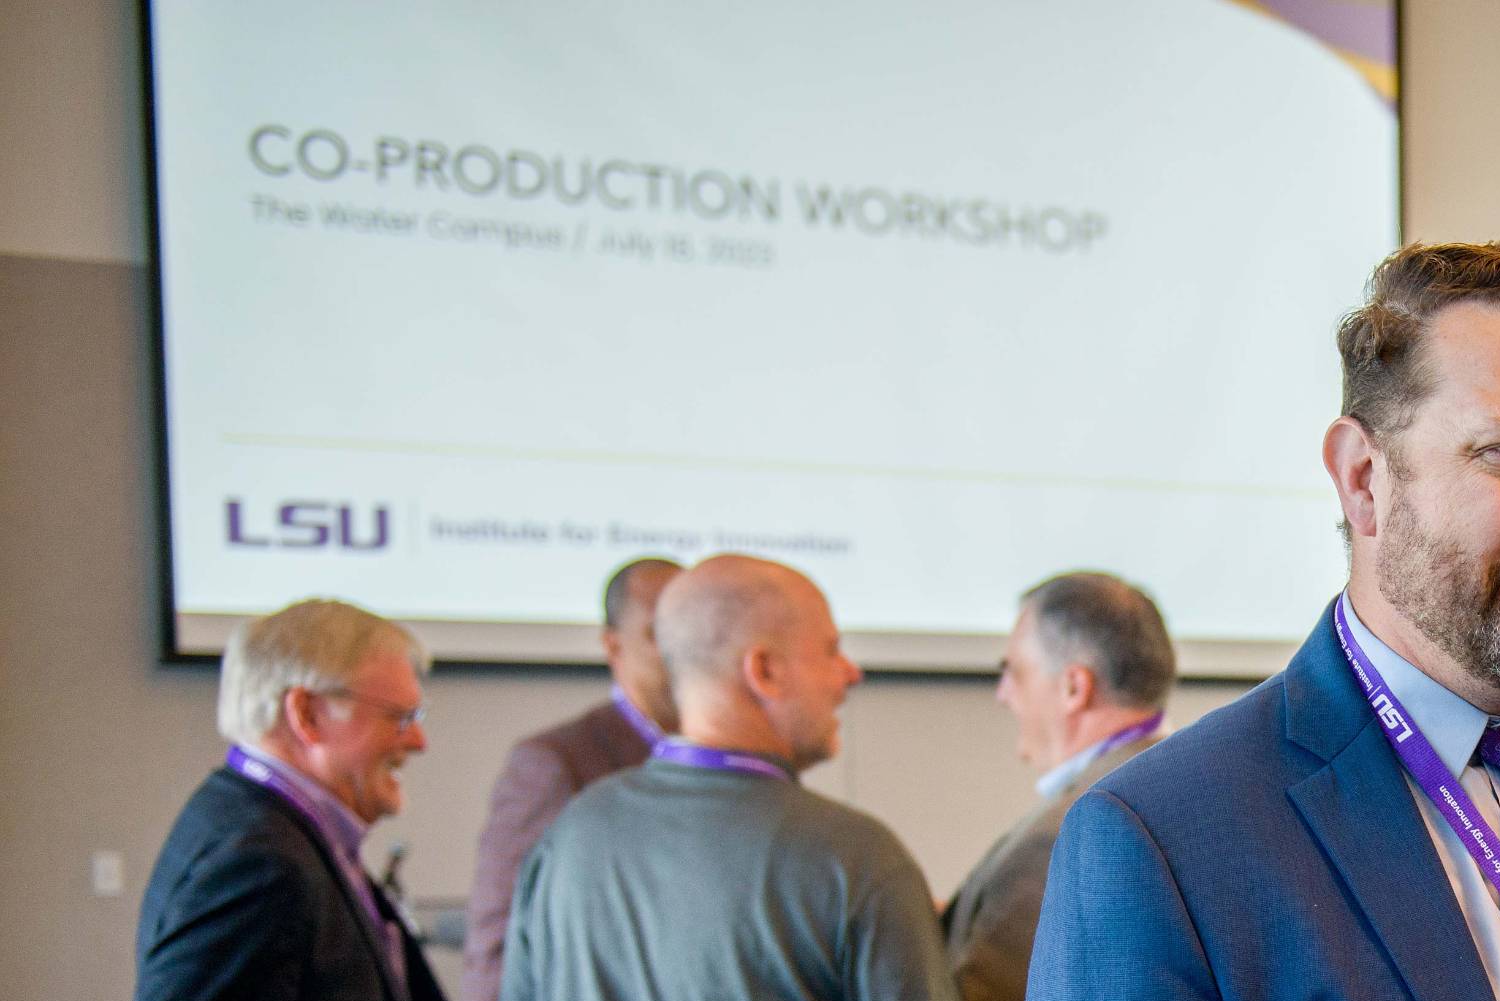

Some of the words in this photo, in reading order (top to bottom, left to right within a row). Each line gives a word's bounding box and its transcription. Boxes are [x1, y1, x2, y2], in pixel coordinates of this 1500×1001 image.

[248, 124, 781, 222] CO-PRODUCTION
[795, 180, 1109, 253] WORKSHOP
[251, 193, 310, 227] The
[319, 200, 417, 236] Water
[425, 209, 564, 249] Campus
[597, 231, 654, 262] July
[225, 496, 390, 551] LSU
[429, 514, 549, 543] Institute
[558, 519, 595, 544] for
[605, 521, 702, 549] Energy
[713, 526, 856, 553] Innovation
[1352, 659, 1373, 692] Institute
[1371, 693, 1413, 743] LSU
[1439, 785, 1473, 830] Innovation
[1470, 828, 1495, 861] Energy
